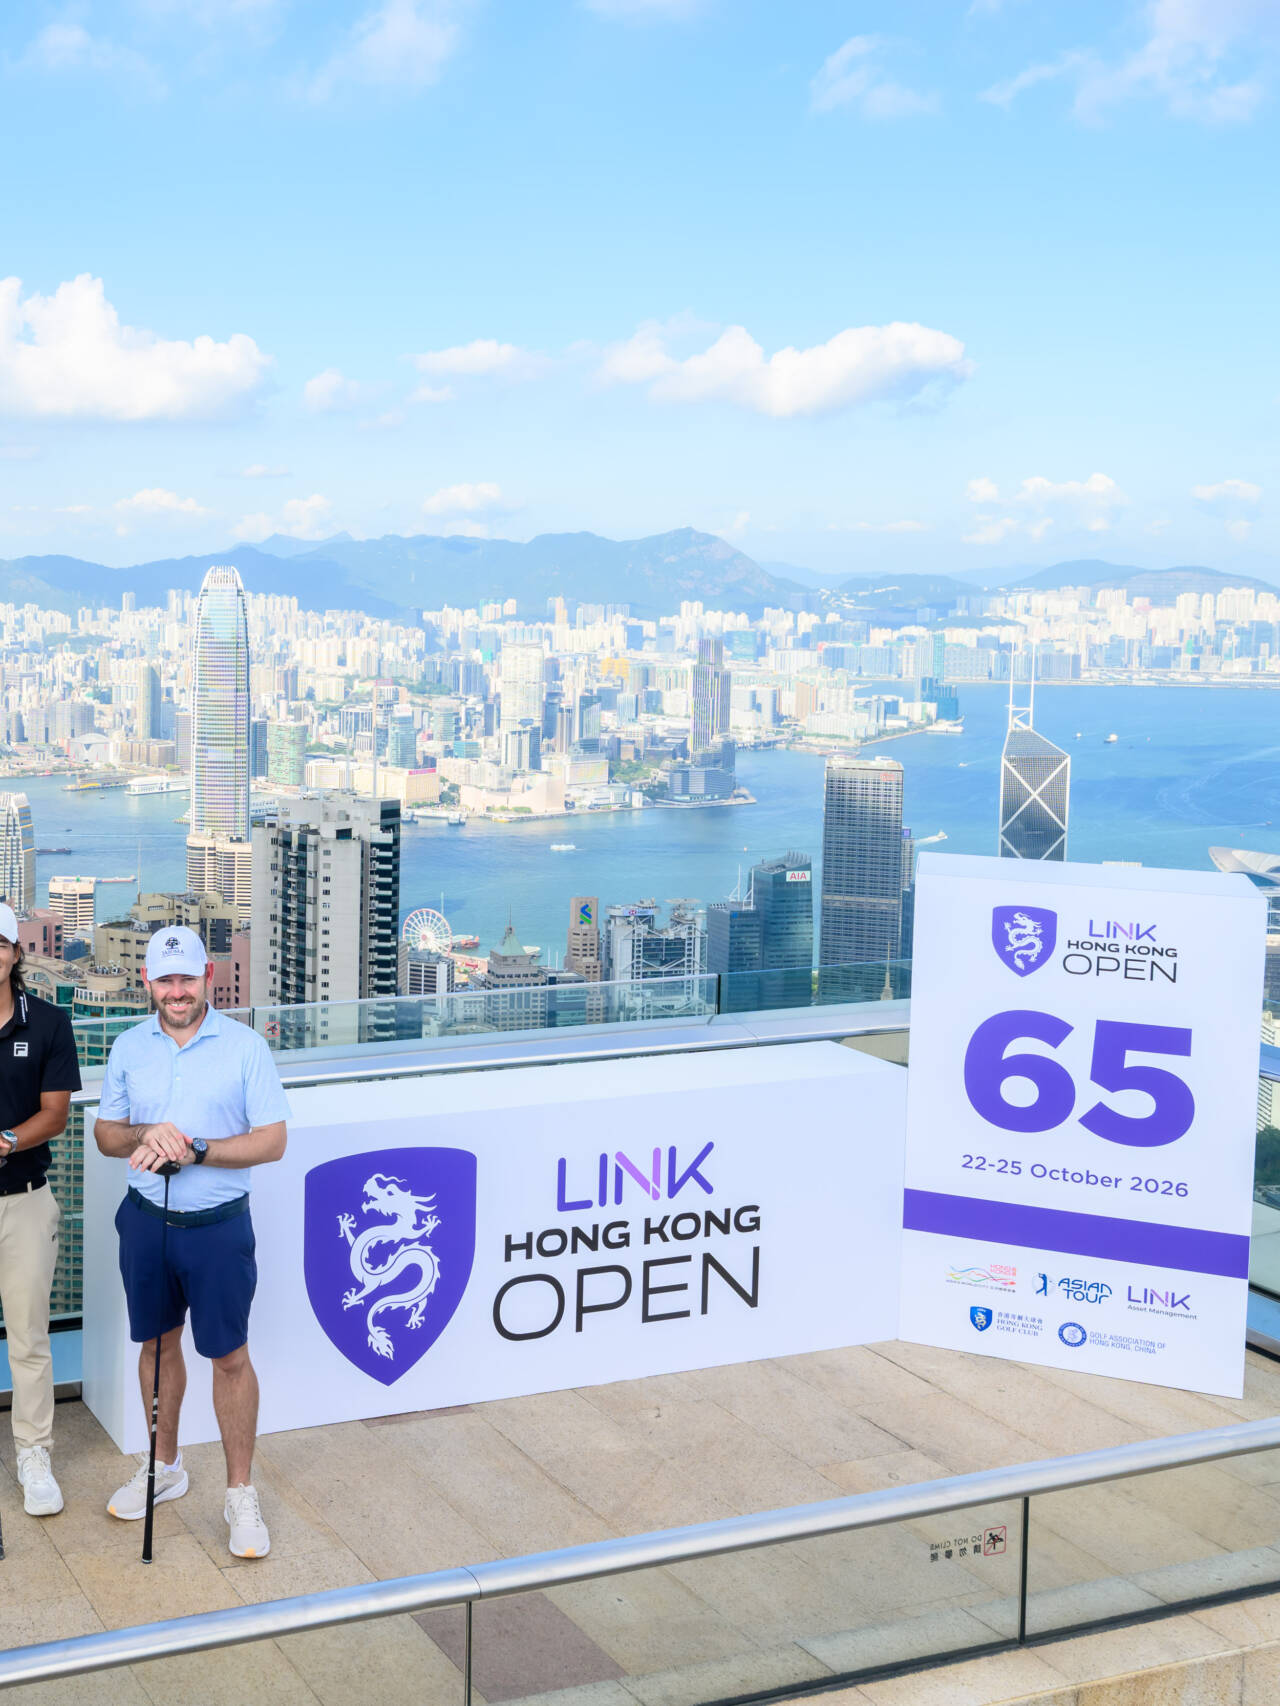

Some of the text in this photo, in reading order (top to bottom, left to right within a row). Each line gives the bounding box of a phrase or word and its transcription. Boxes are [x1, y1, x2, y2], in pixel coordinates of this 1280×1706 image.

[790, 871, 807, 881] AIA
[1089, 919, 1157, 942] LINK
[1067, 939, 1178, 958] HONG KONG
[1062, 953, 1177, 984] OPEN
[964, 1009, 1196, 1148] 65
[557, 1141, 715, 1212] LINK
[961, 1154, 1189, 1198] 22-25 October 2026
[504, 1204, 761, 1263] HONG KONG
[492, 1246, 760, 1342] OPEN
[1057, 1277, 1113, 1295] ASIAN
[1062, 1288, 1110, 1304] TOUR
[1127, 1285, 1191, 1311] LINK
[1127, 1304, 1197, 1320] Asset Management
[996, 1325, 1039, 1337] GOLF CLUB
[997, 1319, 1043, 1331] HONG KONG
[1089, 1331, 1167, 1350] GOLF ASSOCIATION OF
[1089, 1339, 1110, 1347] HONG
[1134, 1345, 1157, 1354] CHINA
